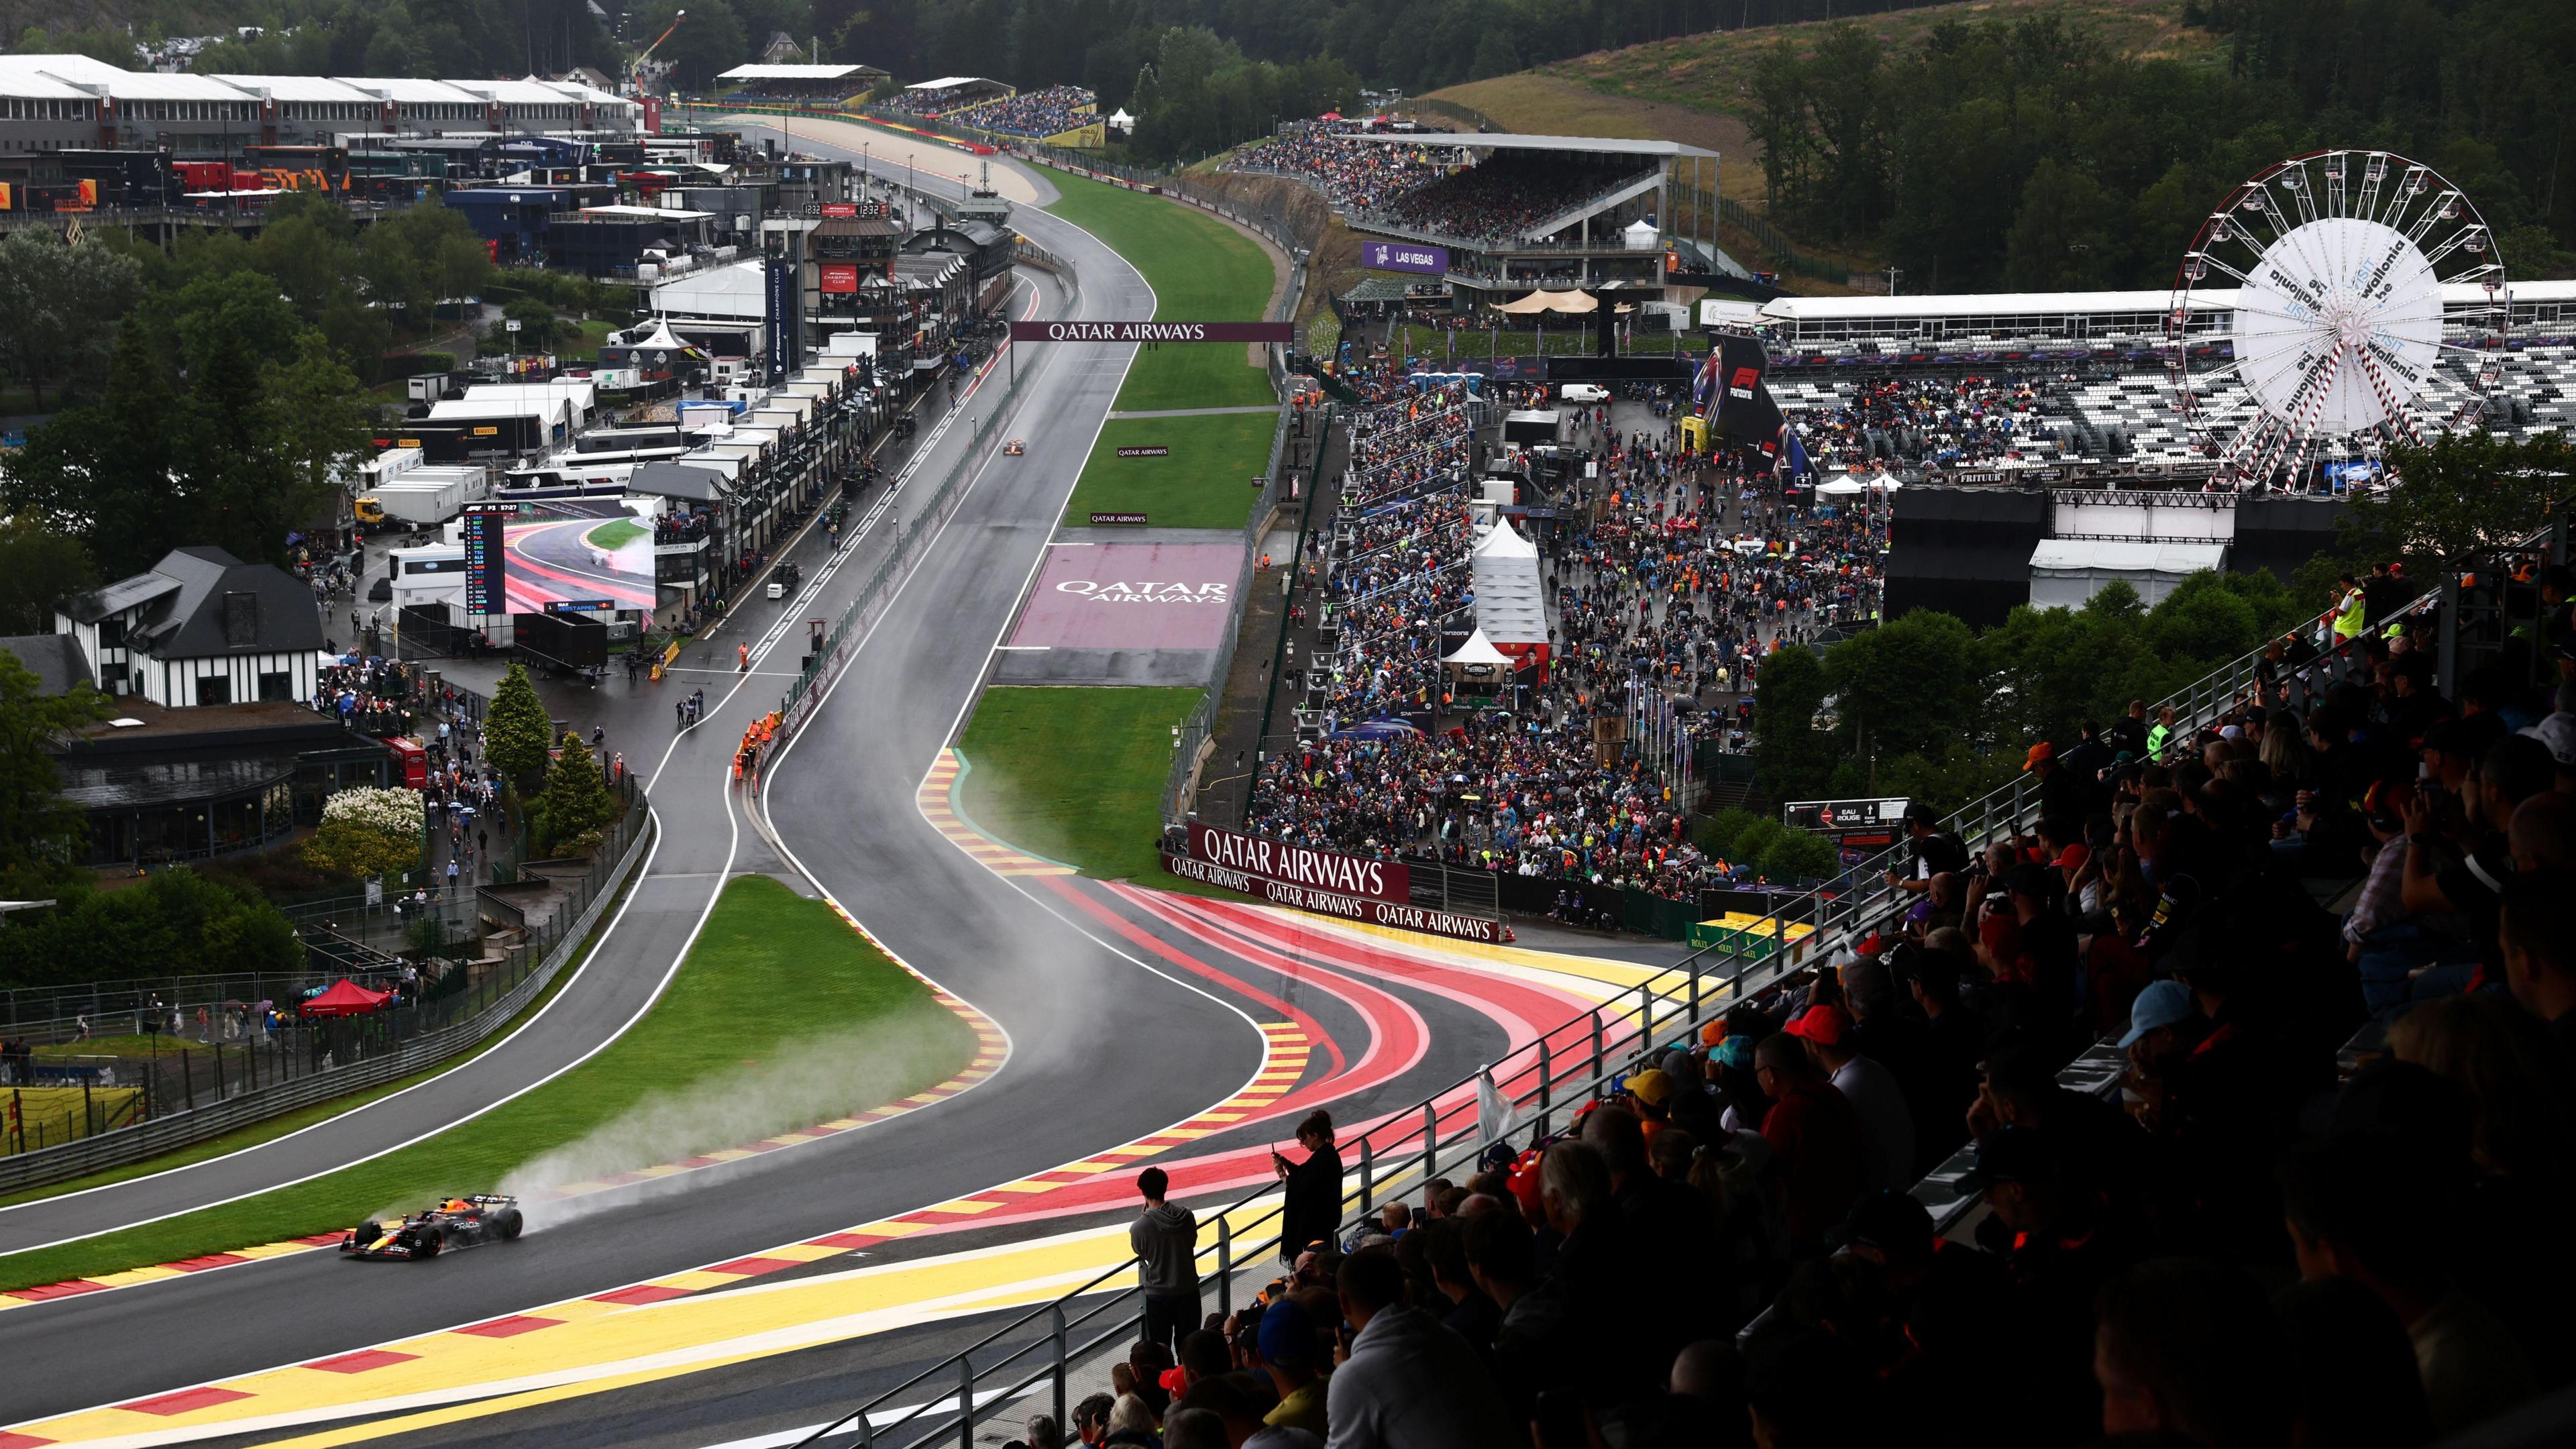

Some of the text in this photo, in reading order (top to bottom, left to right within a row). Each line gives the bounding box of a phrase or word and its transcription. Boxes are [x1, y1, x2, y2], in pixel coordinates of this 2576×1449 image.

[805, 205, 820, 214] 12:32
[860, 205, 879, 215] 12:32
[1396, 252, 1434, 266] LAS VEGAS
[2361, 239, 2406, 300] wallonia
[2269, 269, 2322, 313] wallonia
[1049, 323, 1205, 340] QATAR AIRWAYS
[2367, 340, 2419, 384] wallonia
[1960, 472, 2001, 483] FRITUUR
[1056, 581, 1228, 595] QATAR
[1088, 594, 1227, 604] AIRWAYS
[816, 653, 839, 696] QATAR AIRWAYS
[787, 688, 814, 735] QATAR AIRWAYS
[1204, 828, 1383, 896] QATAR AIRWAYS
[1172, 857, 1490, 940] QATAR AIRWAYS QATAR AIRWAYS QATAR AIRWAYS
[1691, 938, 1708, 949] ROLEX
[453, 1222, 480, 1231] ORACLE
